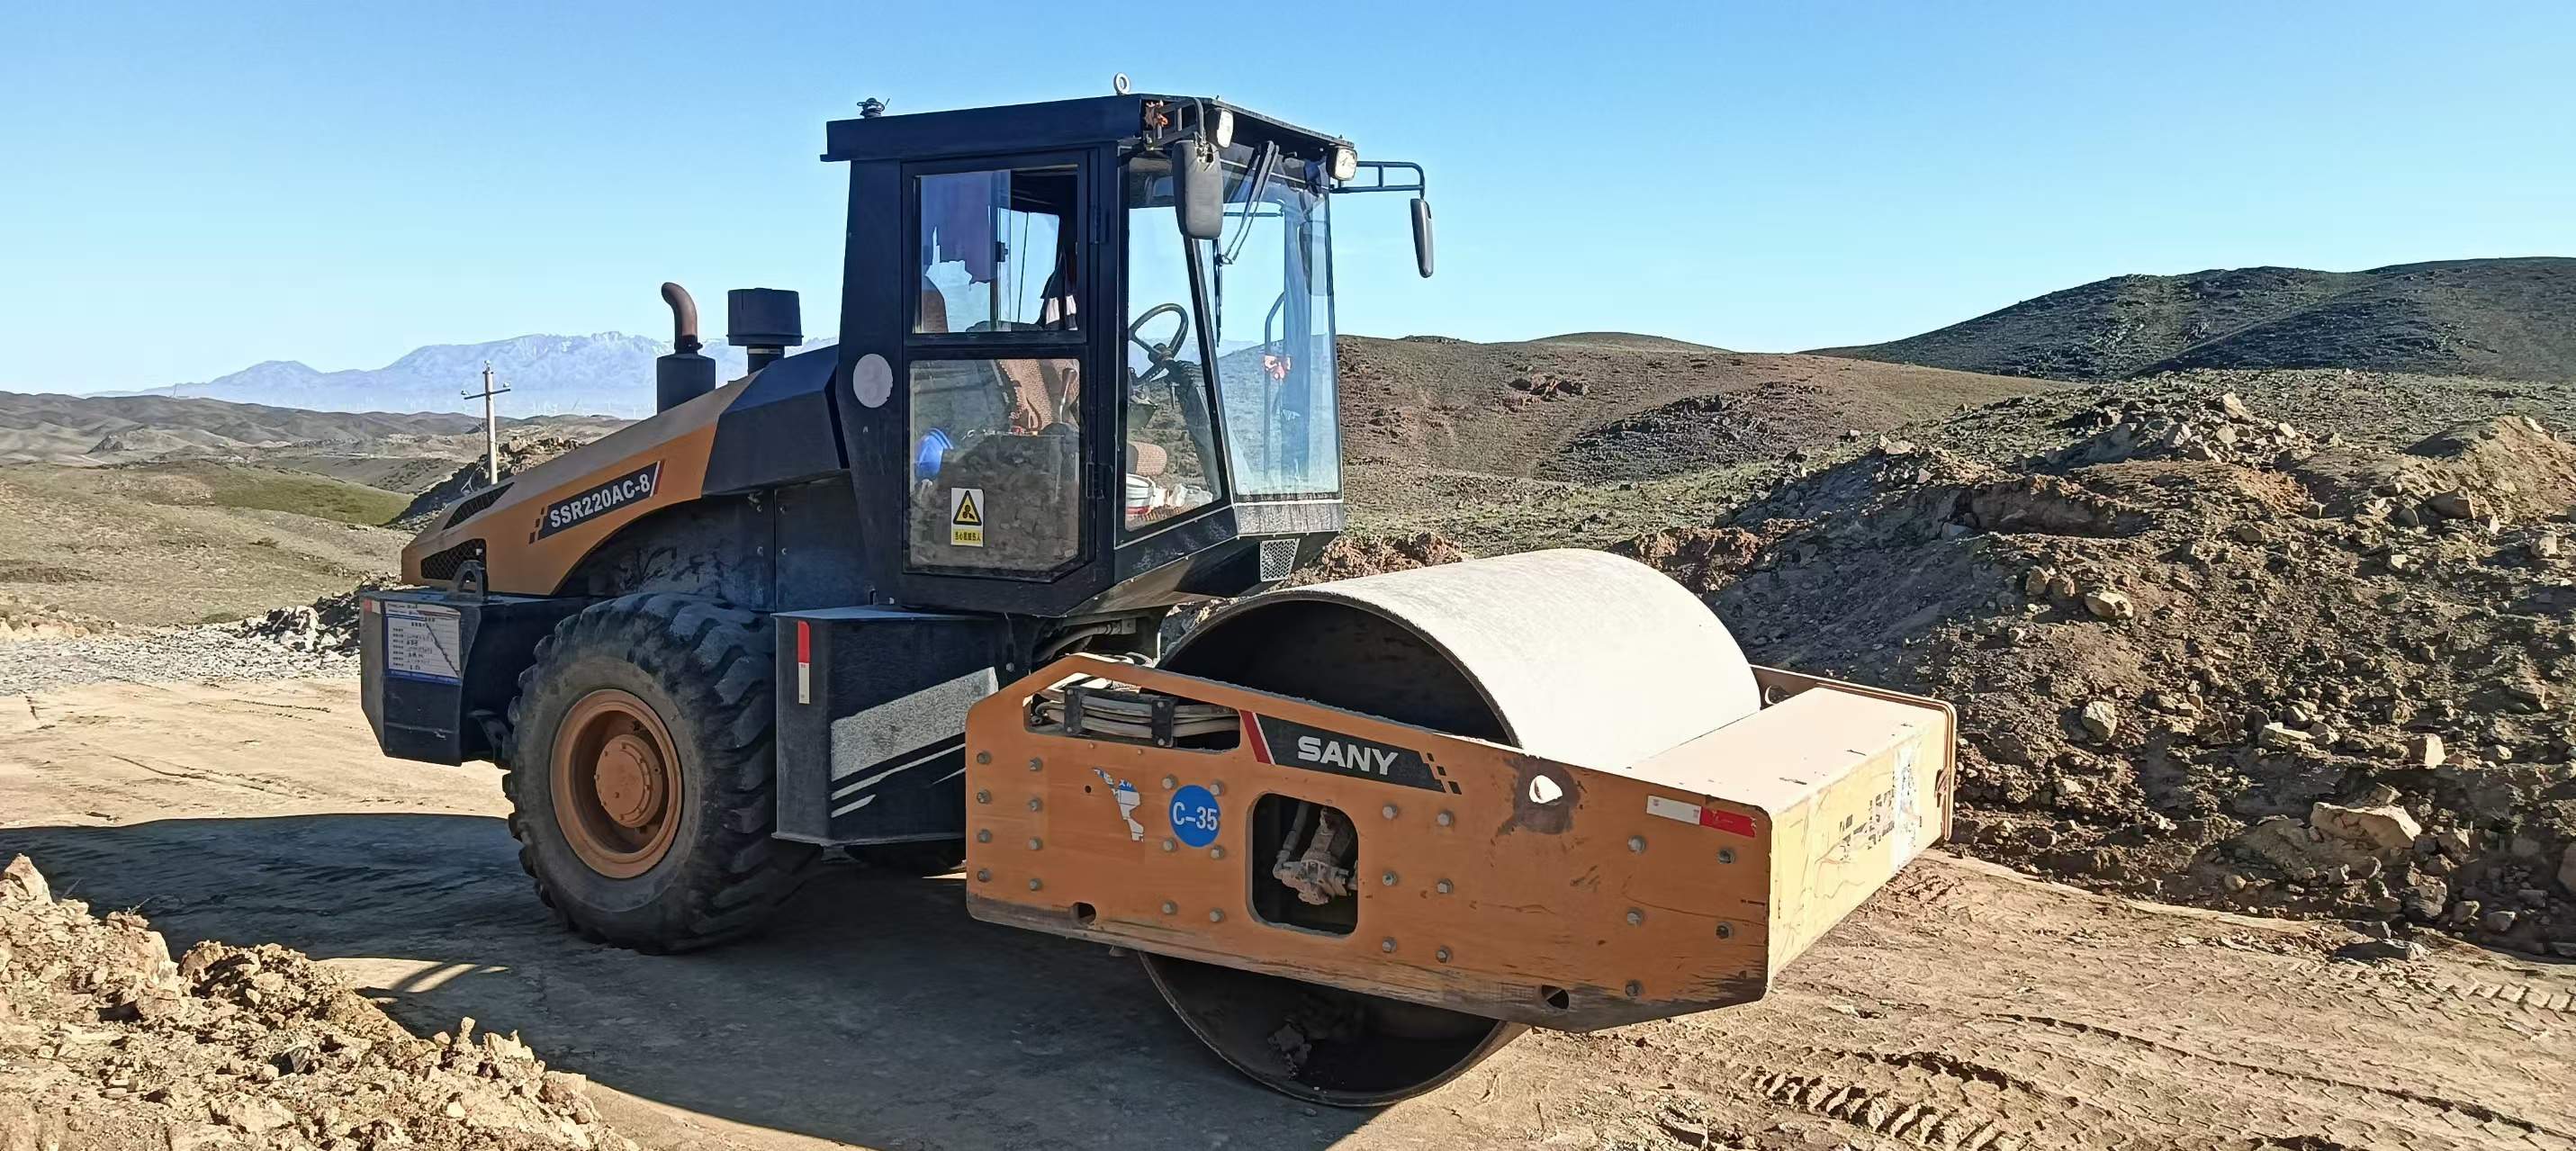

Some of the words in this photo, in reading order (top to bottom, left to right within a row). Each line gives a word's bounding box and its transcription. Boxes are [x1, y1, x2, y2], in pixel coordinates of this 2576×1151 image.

[550, 473, 650, 527] SSR220AC-8
[1298, 735, 1399, 775] SANY
[1173, 802, 1218, 831] C-35
